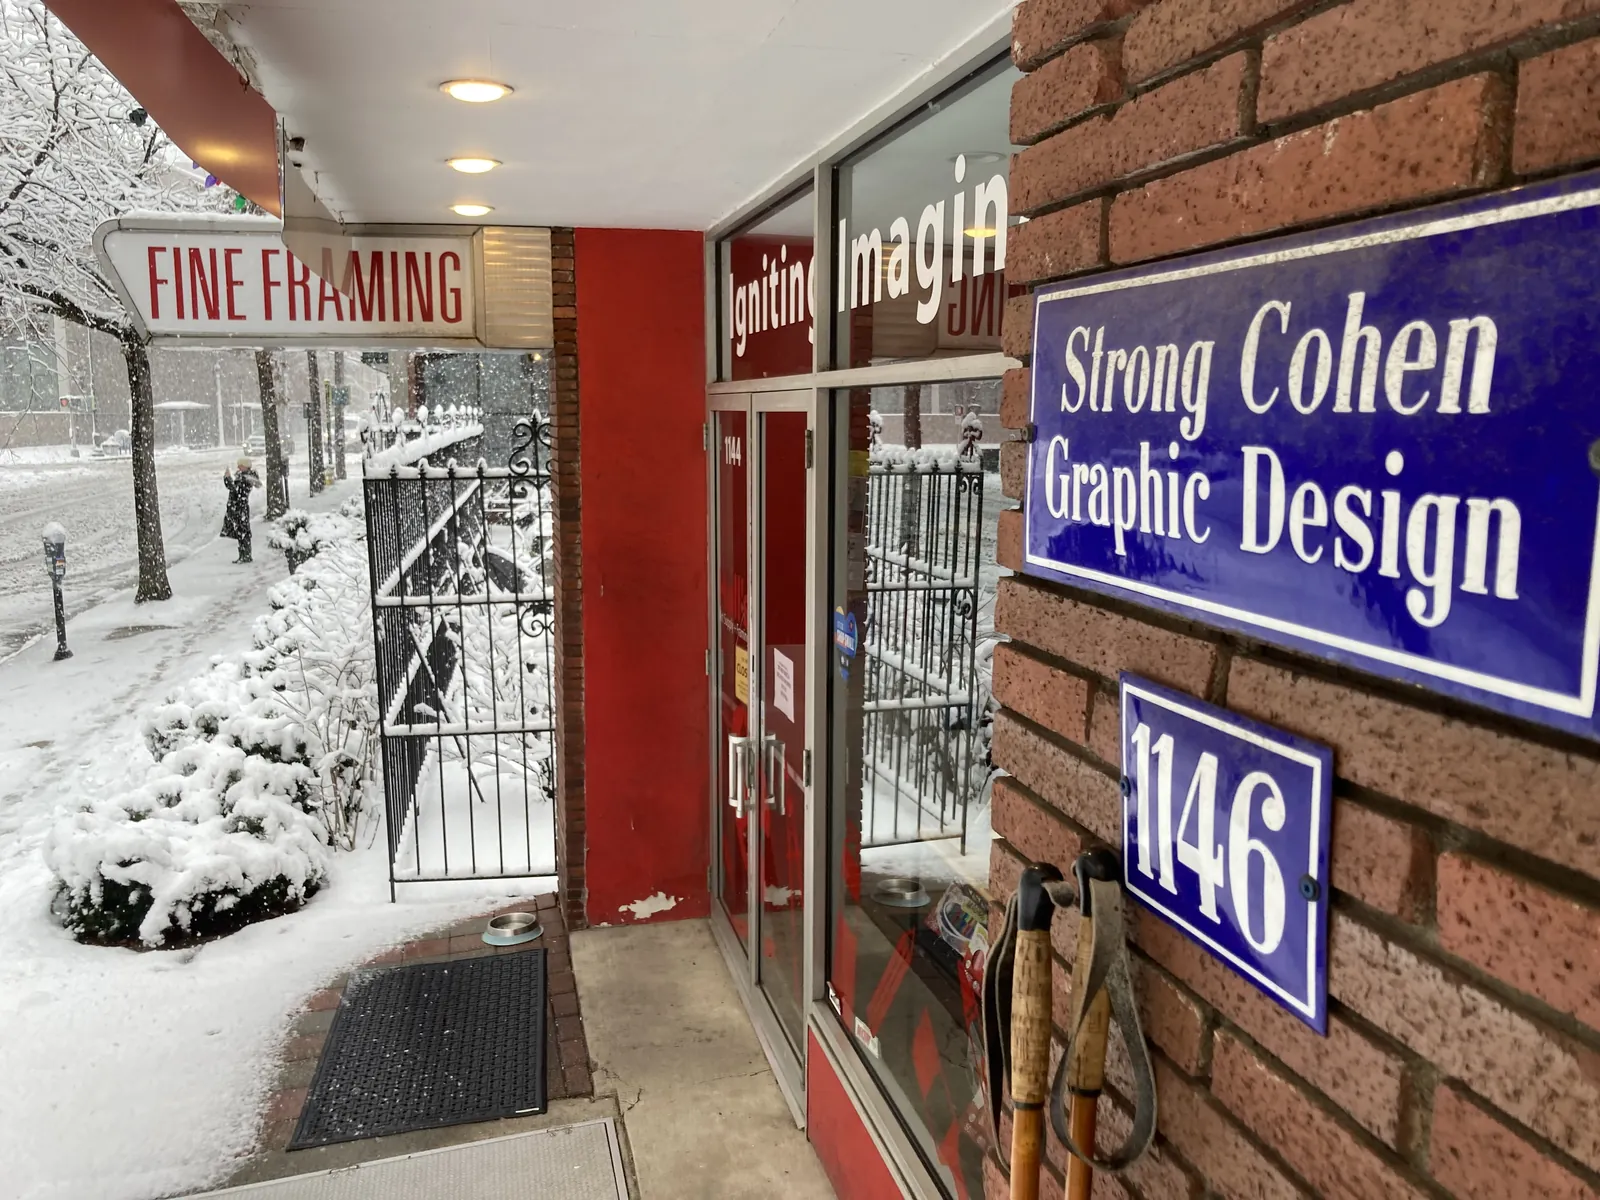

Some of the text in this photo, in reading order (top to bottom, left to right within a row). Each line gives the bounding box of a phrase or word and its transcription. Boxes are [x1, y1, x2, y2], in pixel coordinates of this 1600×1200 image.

[147, 246, 463, 324] FINE FRAMING
[1060, 291, 1499, 441] Strong Cohen
[724, 435, 742, 467] 1144
[1045, 434, 1523, 628] Graphic Design
[1130, 721, 1287, 956] 1146
